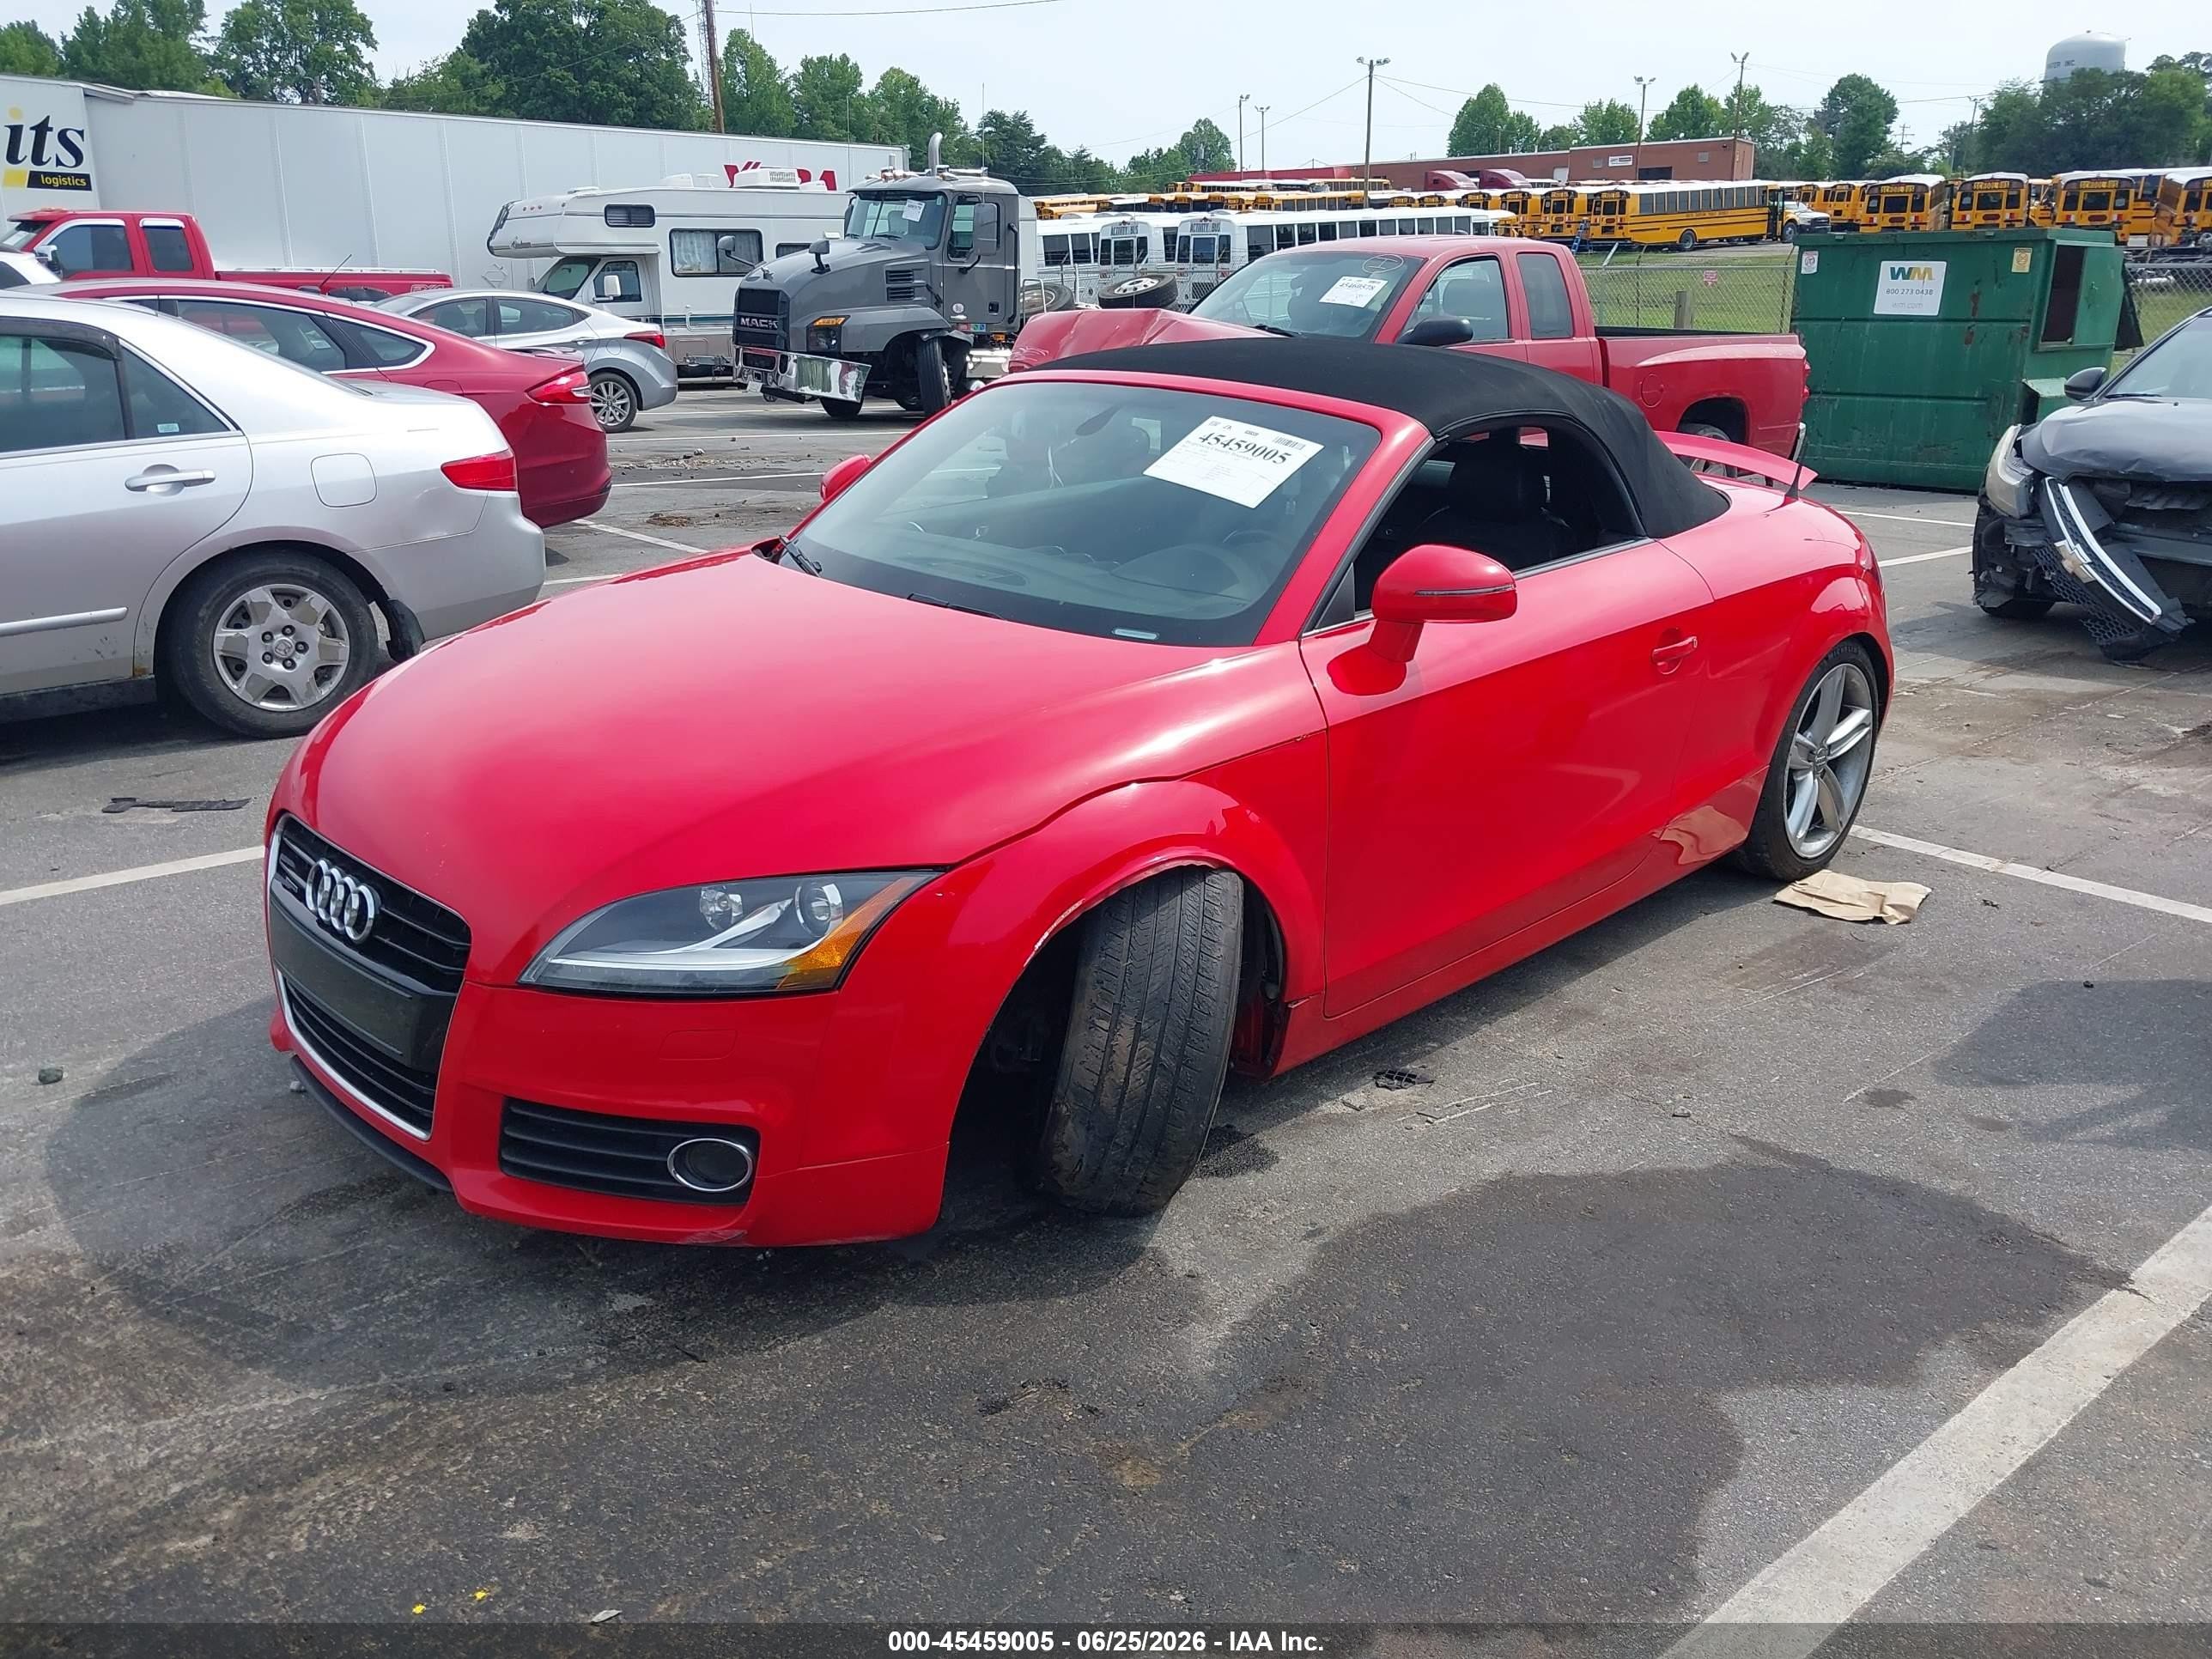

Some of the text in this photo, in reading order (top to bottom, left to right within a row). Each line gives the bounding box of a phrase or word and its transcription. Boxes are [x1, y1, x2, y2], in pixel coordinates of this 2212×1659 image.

[4, 106, 84, 168] its
[40, 173, 87, 187] logistics
[1110, 225, 1139, 236] ACTIVITY BUS
[1190, 222, 1221, 233] ACTIVITY BUS
[1890, 266, 1934, 281] WM
[740, 317, 779, 329] MACK
[1199, 432, 1292, 465] 45459005
